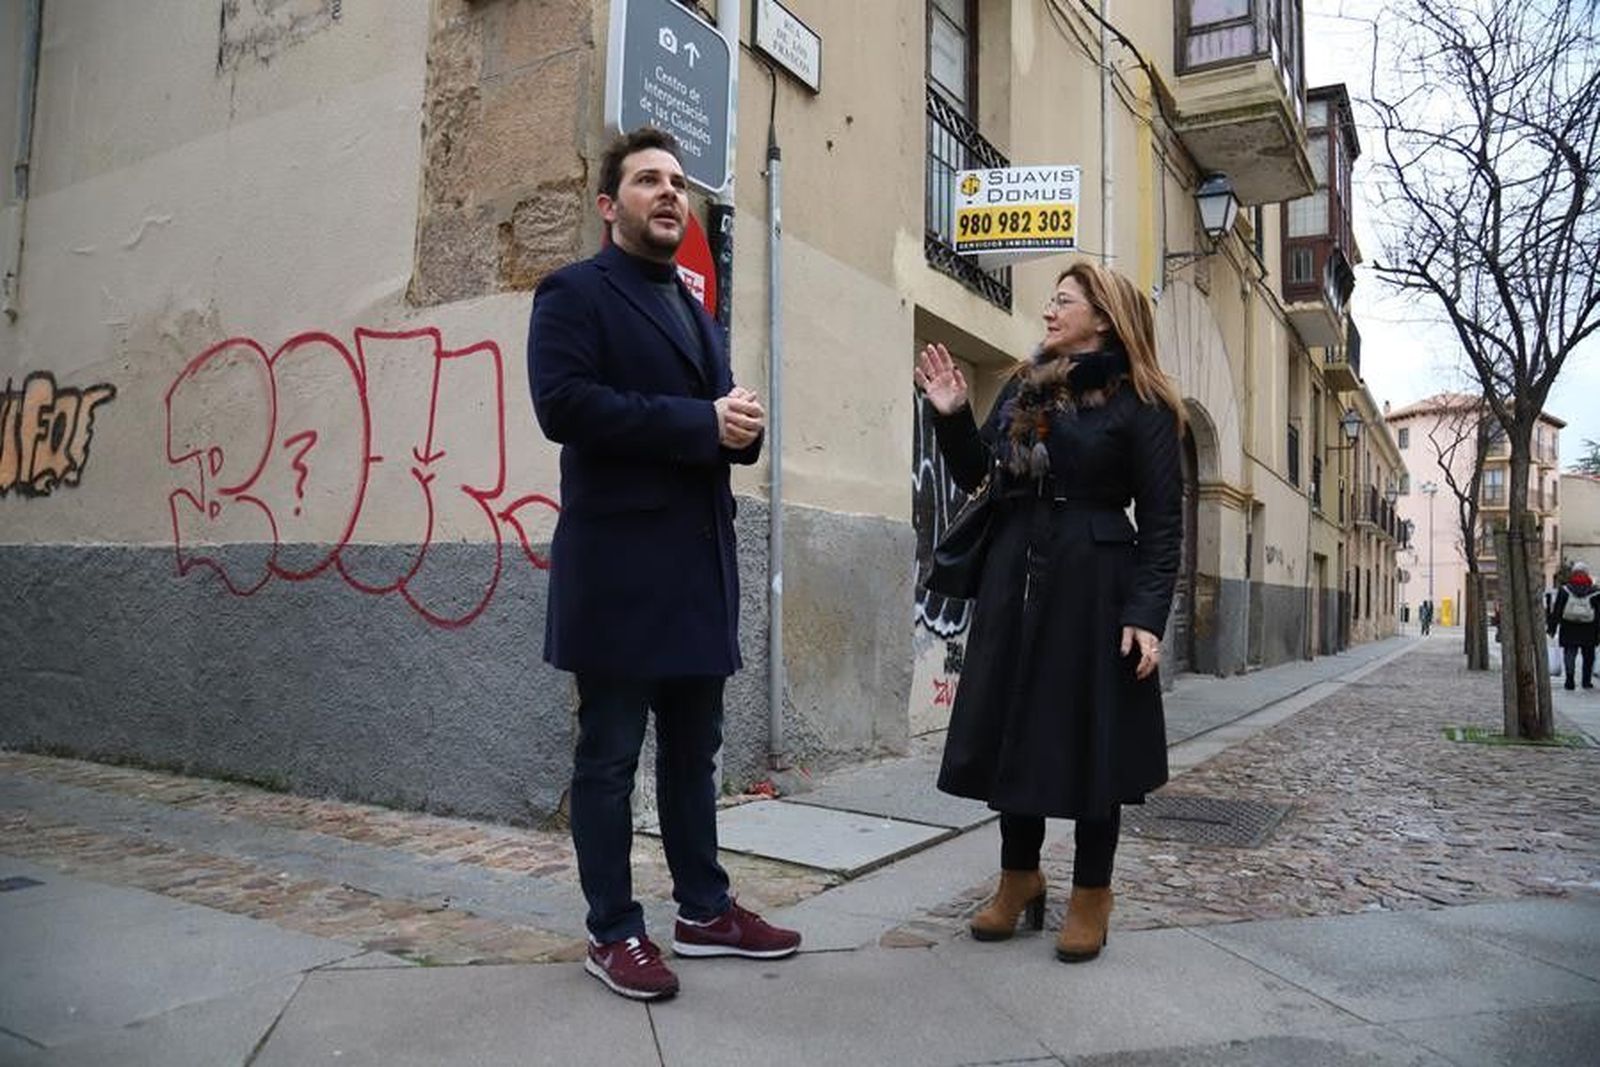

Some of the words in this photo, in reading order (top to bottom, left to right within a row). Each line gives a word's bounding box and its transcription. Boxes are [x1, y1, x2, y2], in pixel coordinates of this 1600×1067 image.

[655, 66, 688, 99] Centro
[688, 86, 701, 104] de
[644, 78, 710, 127] Interpretación
[639, 97, 652, 113] de
[655, 102, 669, 122] las
[671, 112, 712, 145] Ciudades
[988, 169, 1074, 186] SUAVIS
[987, 187, 1073, 204] DOMUS
[960, 213, 992, 236] 980
[998, 211, 1031, 233] 982
[1038, 210, 1072, 233] 303
